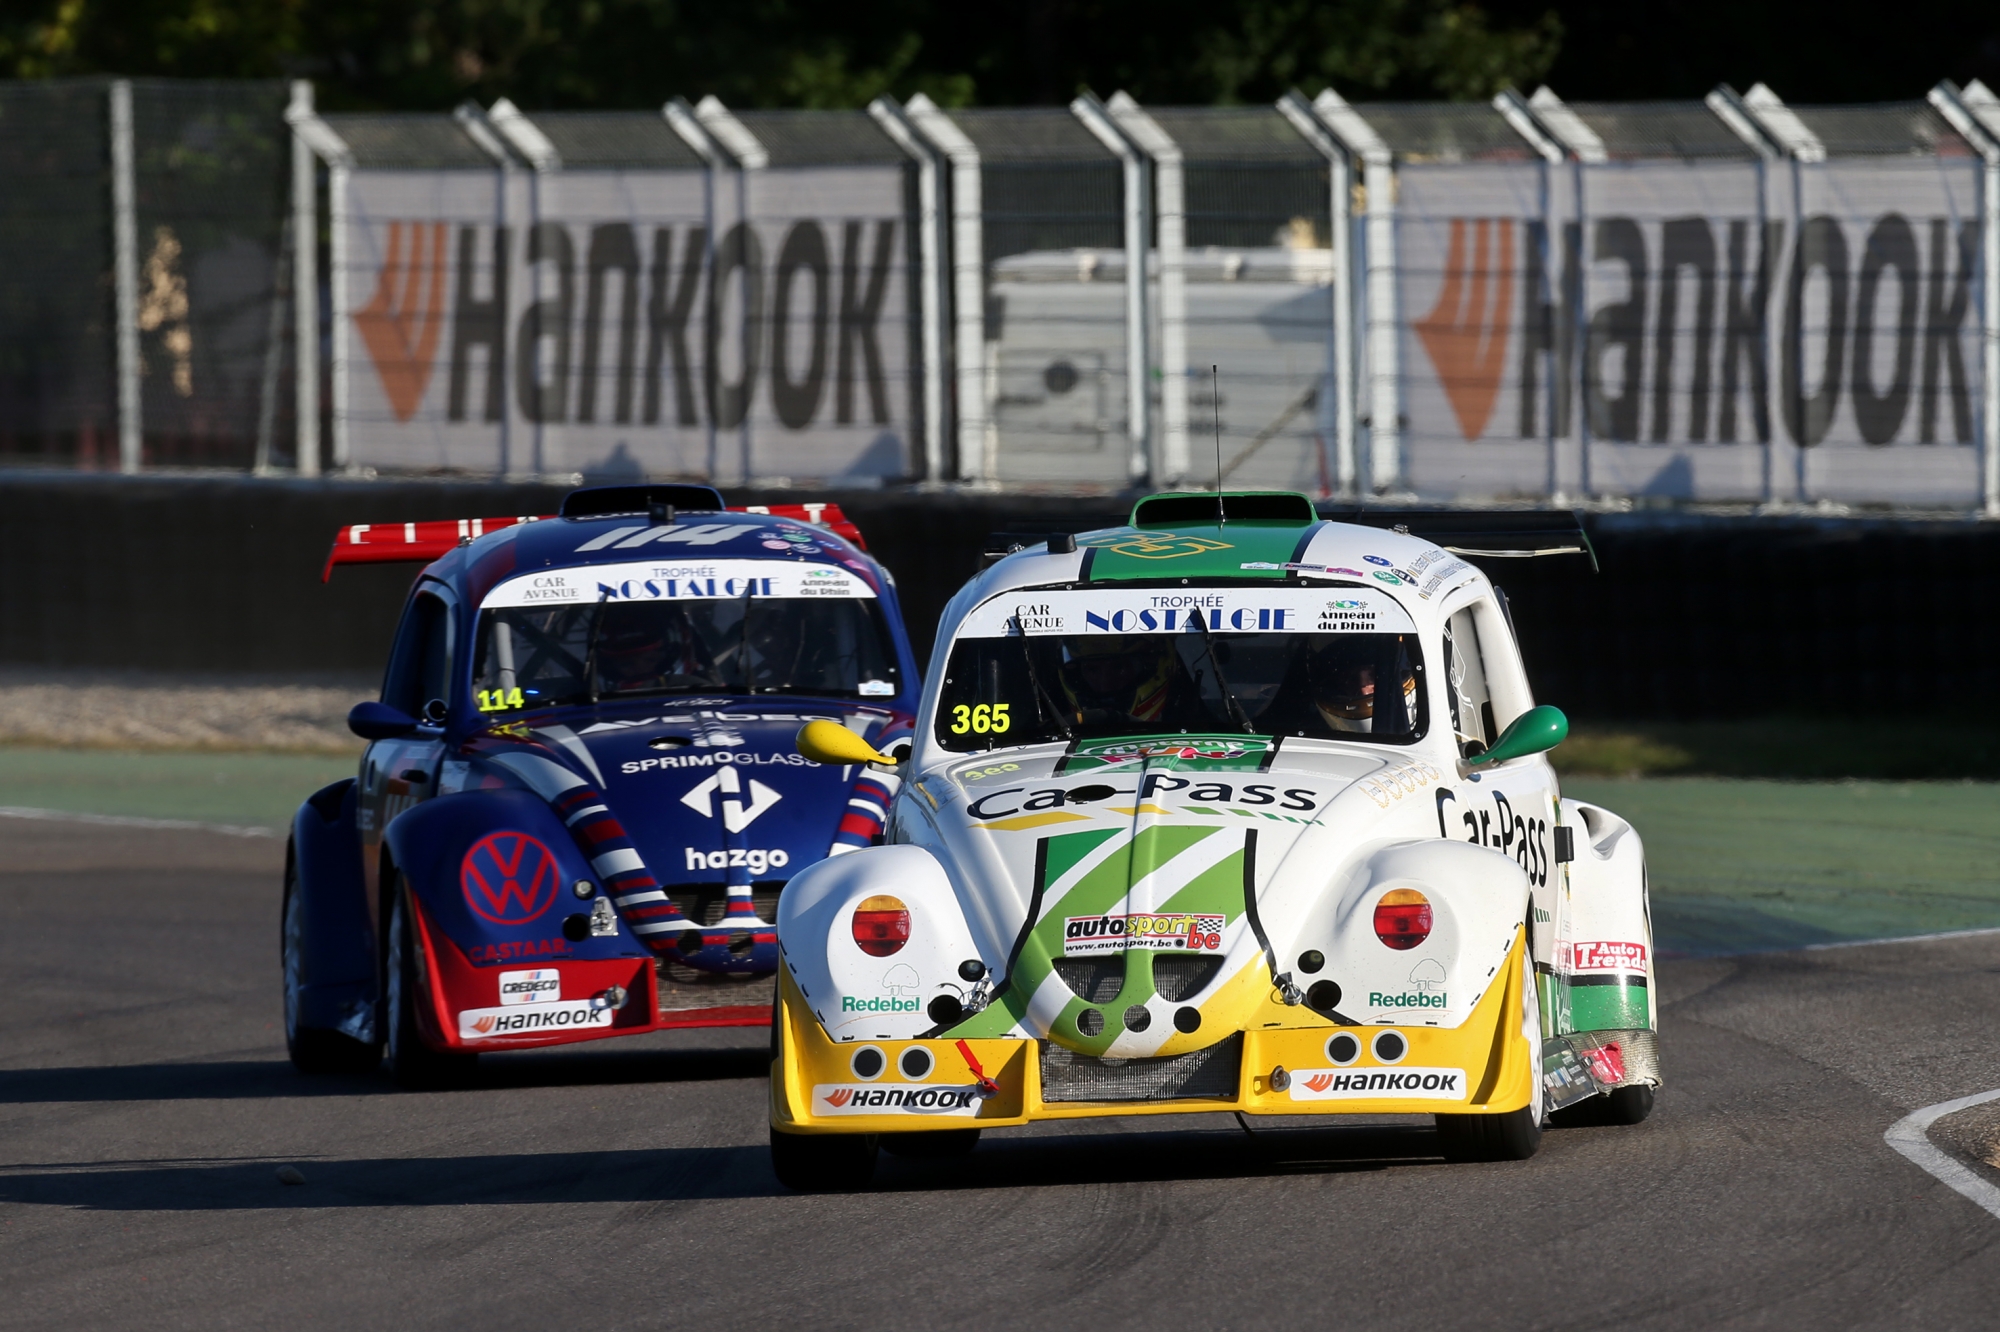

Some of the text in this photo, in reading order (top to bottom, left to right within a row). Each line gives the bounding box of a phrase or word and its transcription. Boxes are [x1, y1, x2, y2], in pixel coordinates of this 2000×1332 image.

[574, 524, 762, 552] 114
[653, 567, 717, 578] TROPHÉE
[533, 577, 566, 588] CAR
[597, 577, 780, 602] NOSTALGIE
[800, 578, 850, 587] Anneau
[523, 588, 579, 599] AVENUE
[1151, 593, 1224, 608] TROPHÉE
[1015, 604, 1050, 616] CAR
[1318, 611, 1376, 620] Anneau
[1086, 608, 1295, 632] NOSTALGIE
[1318, 621, 1375, 630] du Rhin
[478, 686, 524, 712] 114
[951, 703, 1010, 735] 365
[685, 847, 789, 875] hazgo
[1065, 939, 1172, 951] www.autosport.be
[1596, 942, 1635, 956] Auto
[1576, 942, 1646, 971] Trends
[842, 995, 920, 1012] Redebel
[1368, 992, 1447, 1009] Redebel
